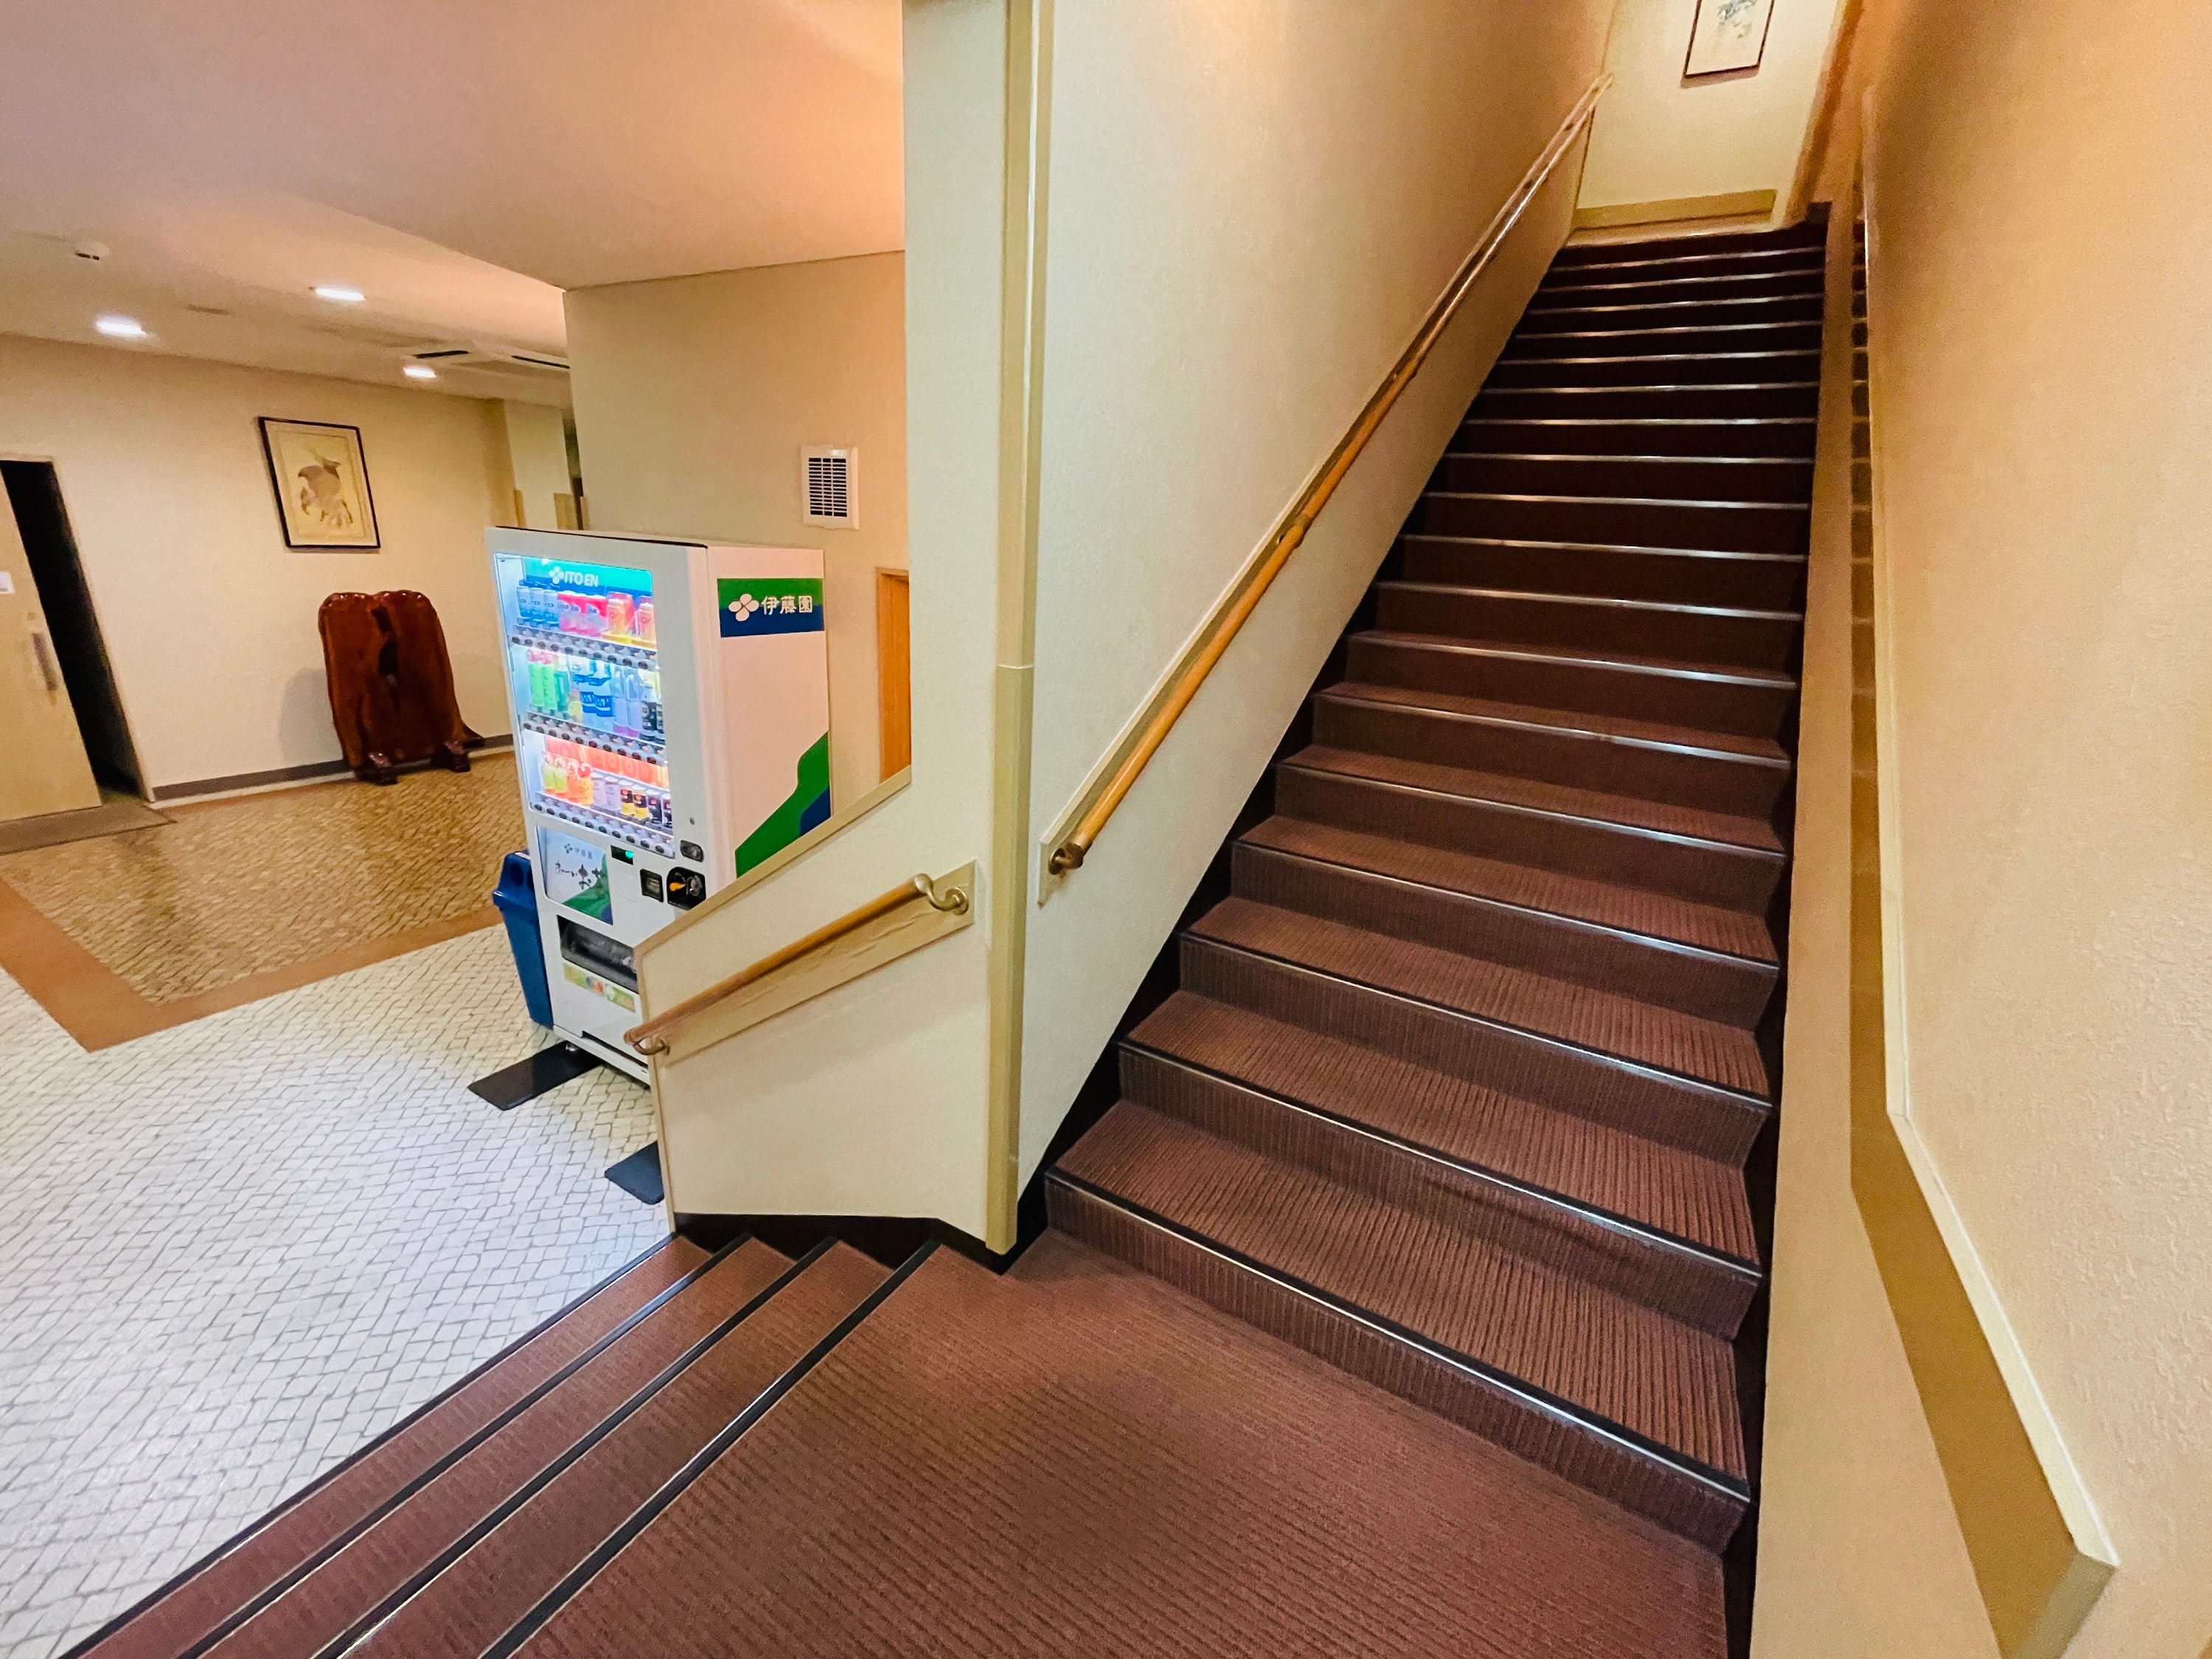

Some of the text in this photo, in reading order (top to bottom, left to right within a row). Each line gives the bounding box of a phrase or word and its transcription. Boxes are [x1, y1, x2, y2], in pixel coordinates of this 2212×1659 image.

[564, 571, 599, 587] ITO EN
[761, 595, 813, 615] 伊藤園
